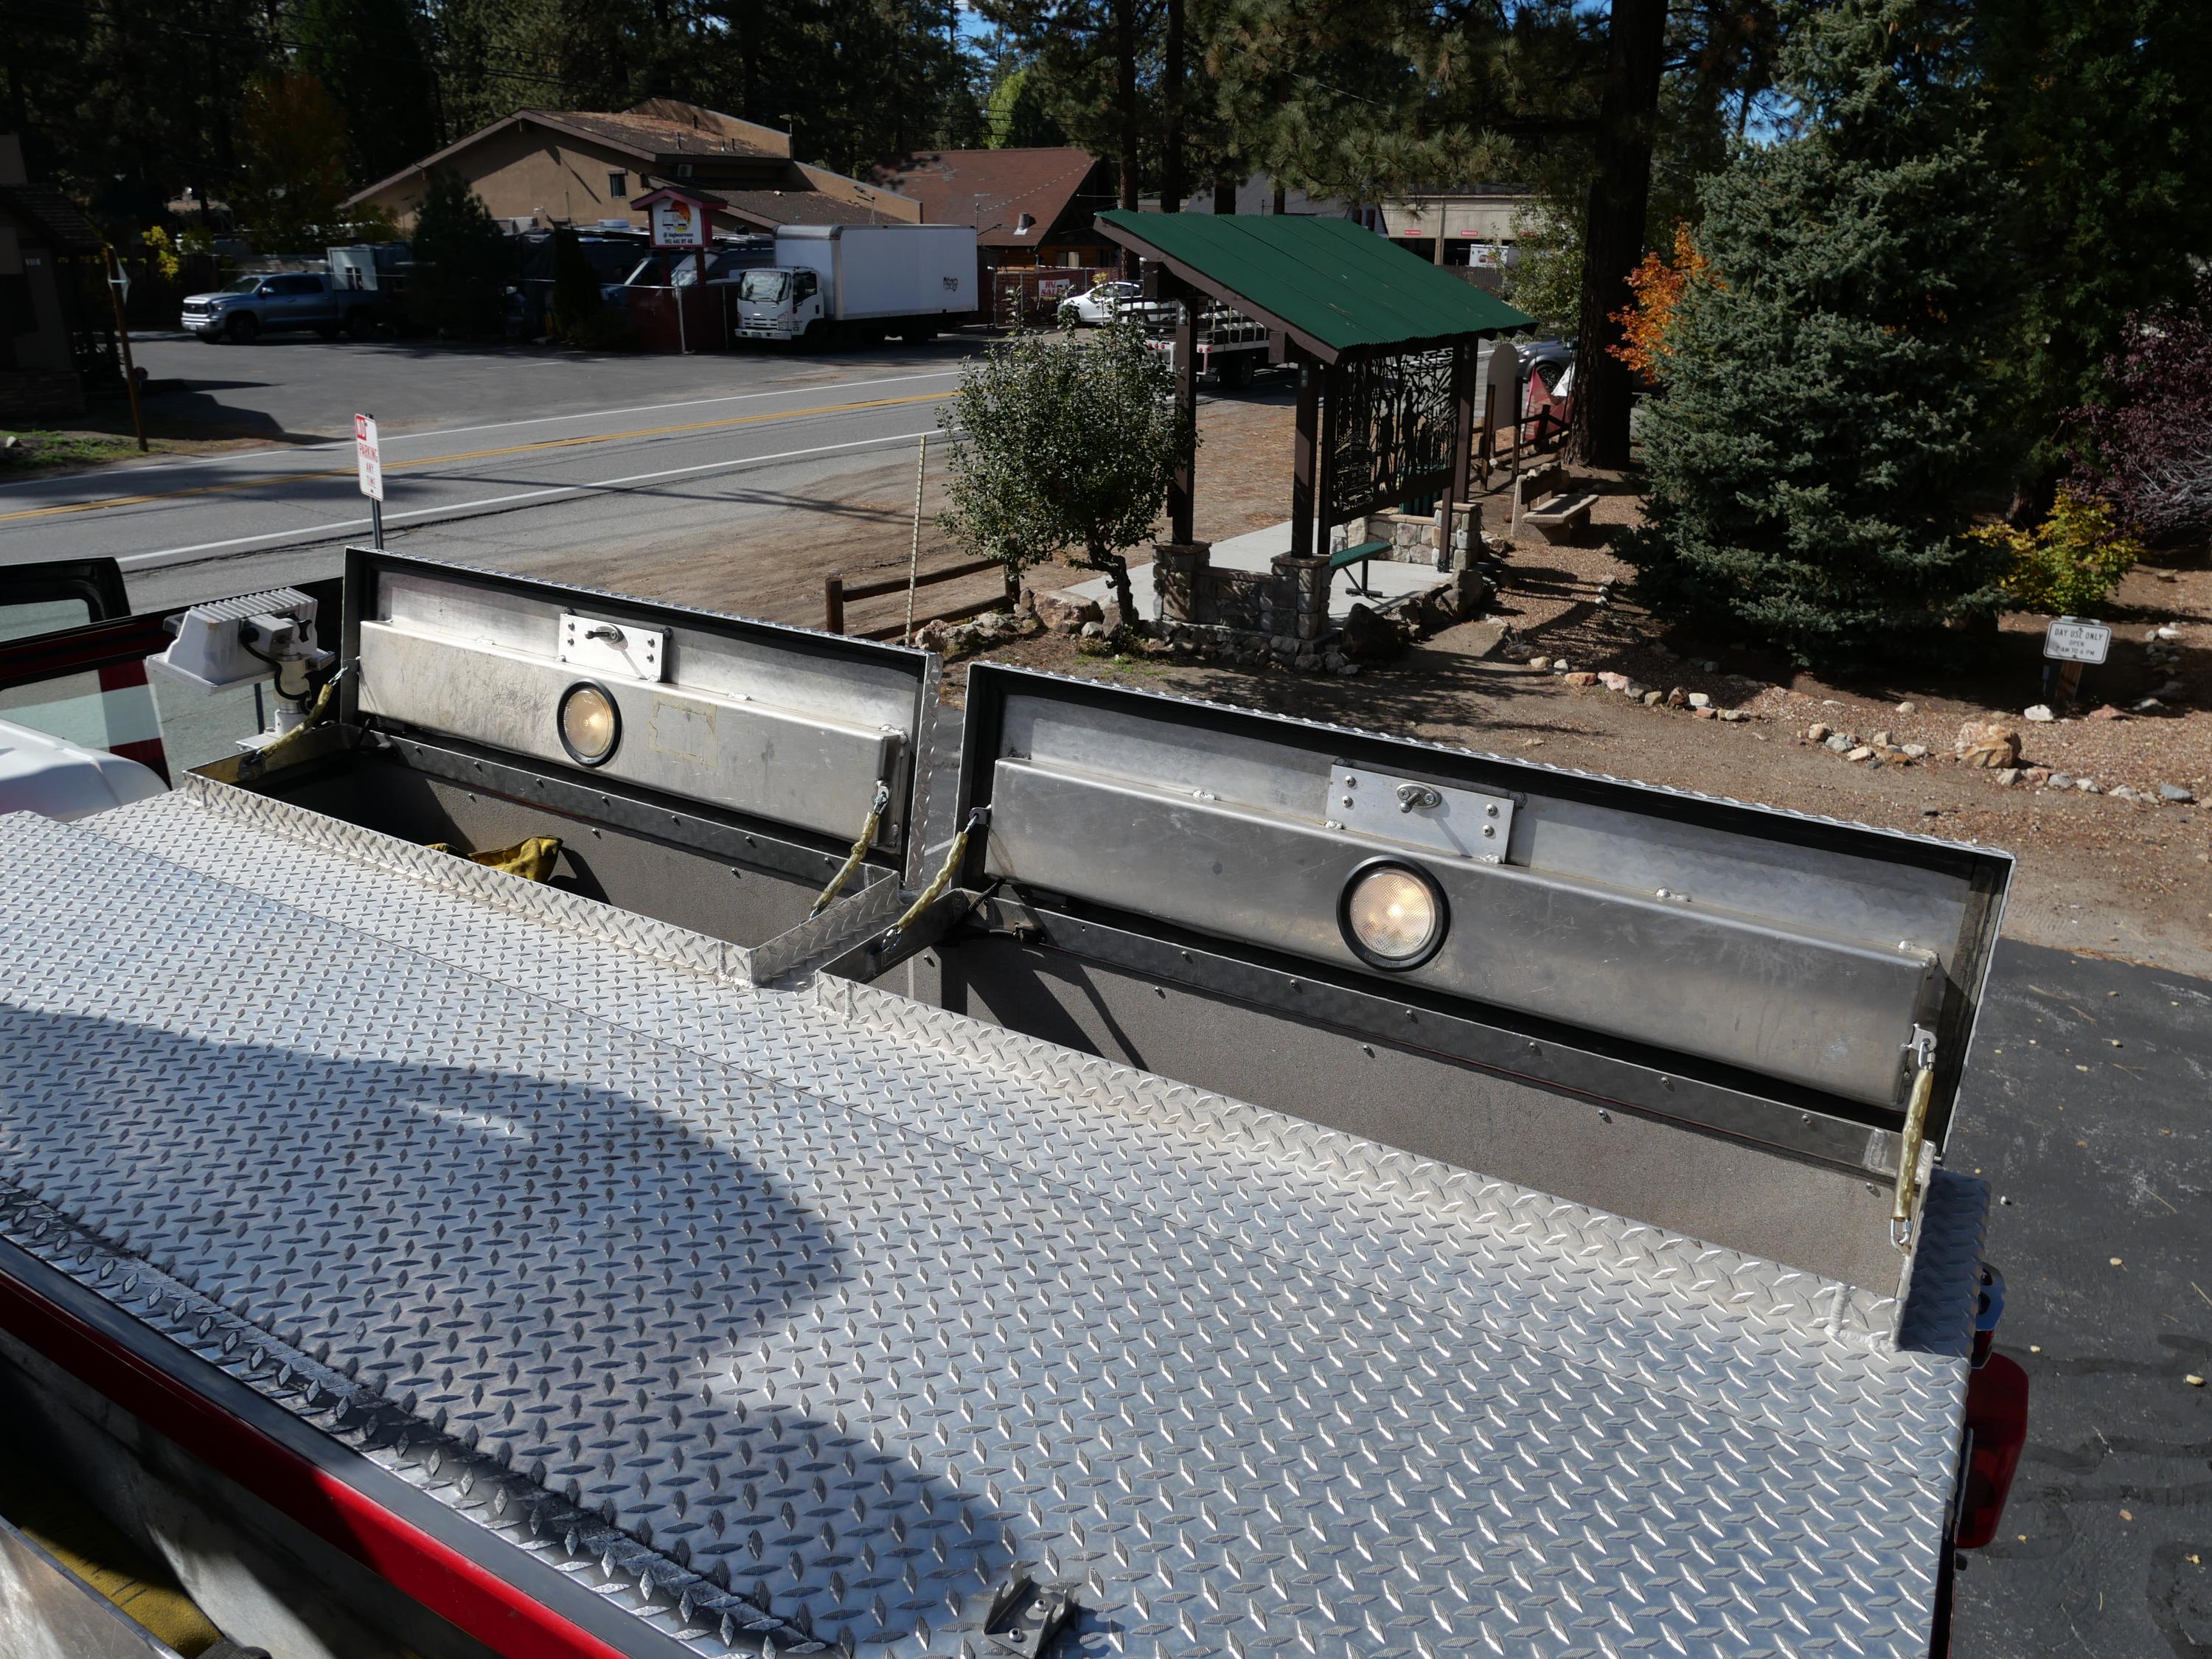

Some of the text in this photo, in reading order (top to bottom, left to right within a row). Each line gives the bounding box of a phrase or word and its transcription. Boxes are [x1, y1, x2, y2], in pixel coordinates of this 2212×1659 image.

[356, 418, 366, 437] NO
[358, 442, 378, 463] PARKING
[366, 462, 375, 474] ANY
[366, 475, 376, 487] TIME
[2054, 628, 2104, 641] DAY USE ONLY
